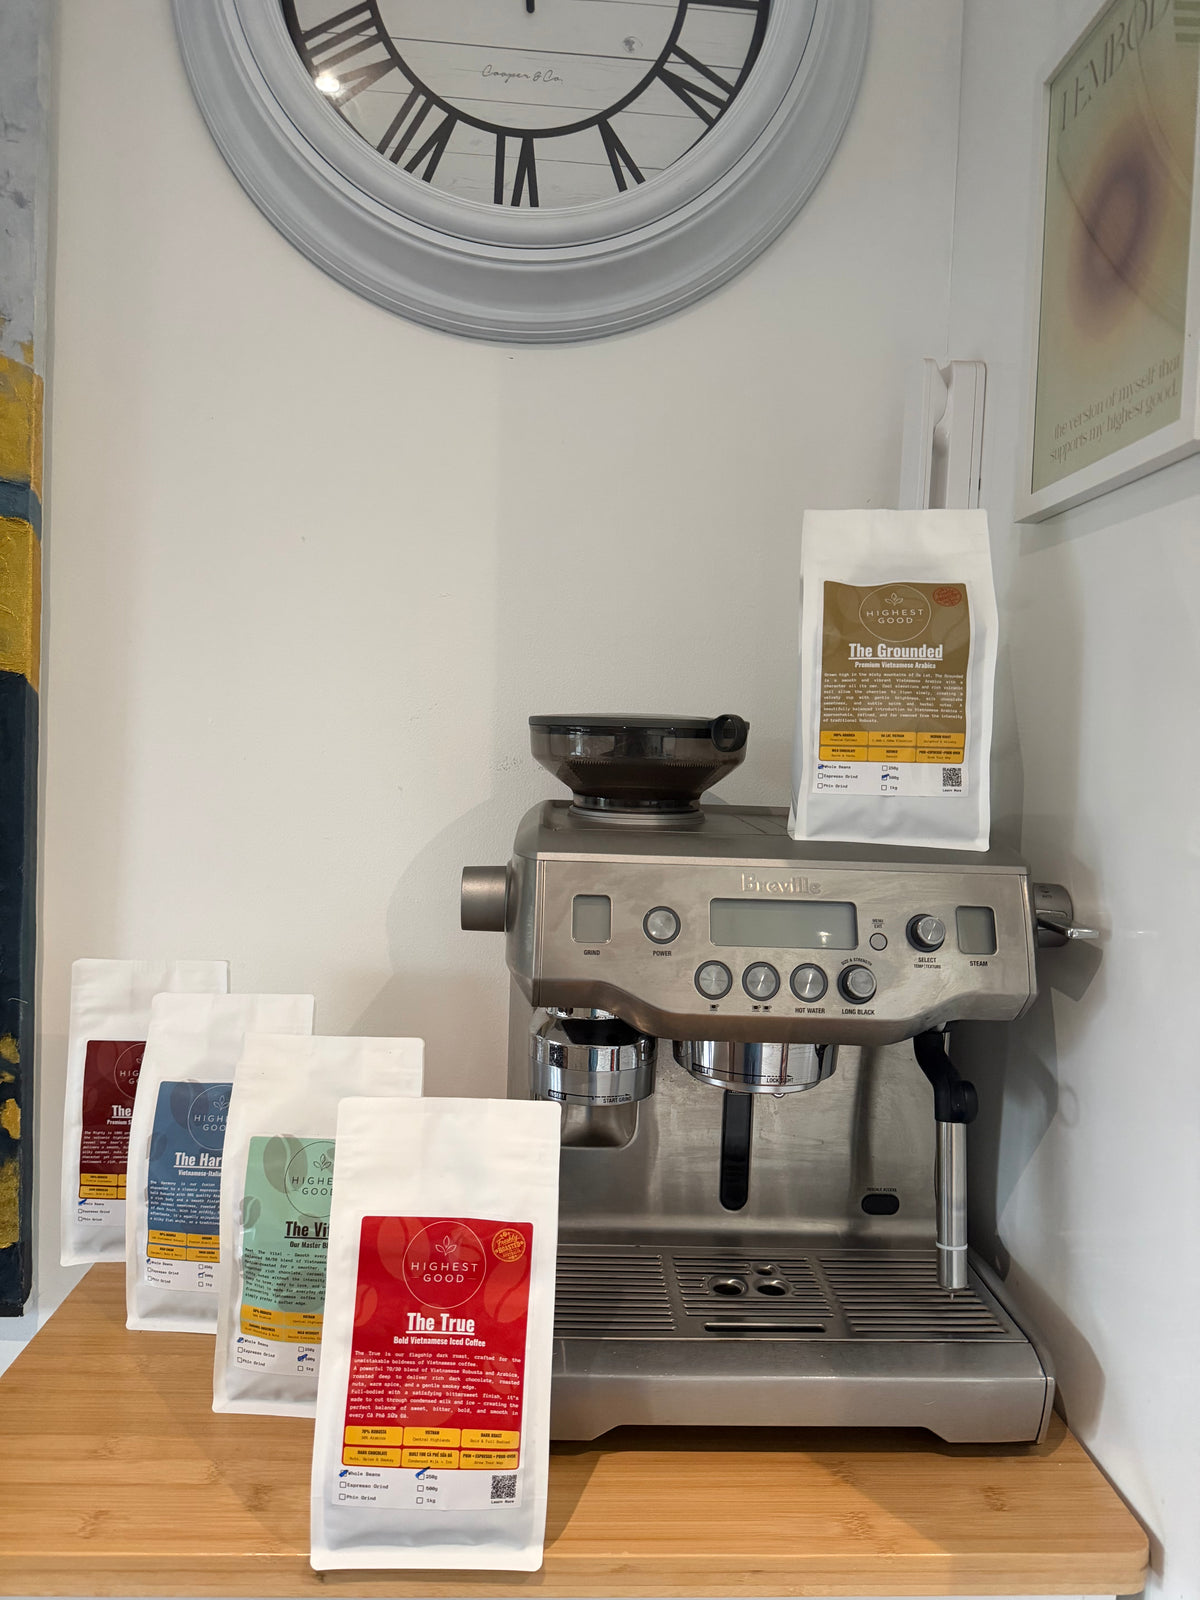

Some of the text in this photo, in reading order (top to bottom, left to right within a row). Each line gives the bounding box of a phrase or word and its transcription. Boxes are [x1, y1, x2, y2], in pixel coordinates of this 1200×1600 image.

[482, 64, 529, 84] Cooper
[866, 609, 924, 617] HIGHEST
[849, 643, 943, 658] The Grounded
[741, 872, 822, 895] Breville
[112, 1105, 132, 1117] The
[202, 1124, 226, 1132] GOO
[175, 1152, 223, 1167] The Har
[292, 1176, 333, 1185] HIGHE
[285, 1221, 329, 1237] The Vi
[411, 1262, 479, 1273] HIGHEST
[423, 1274, 465, 1283] GOOD
[407, 1312, 475, 1332] The True
[393, 1336, 486, 1348] Bold Vietnamese Iced Coffee
